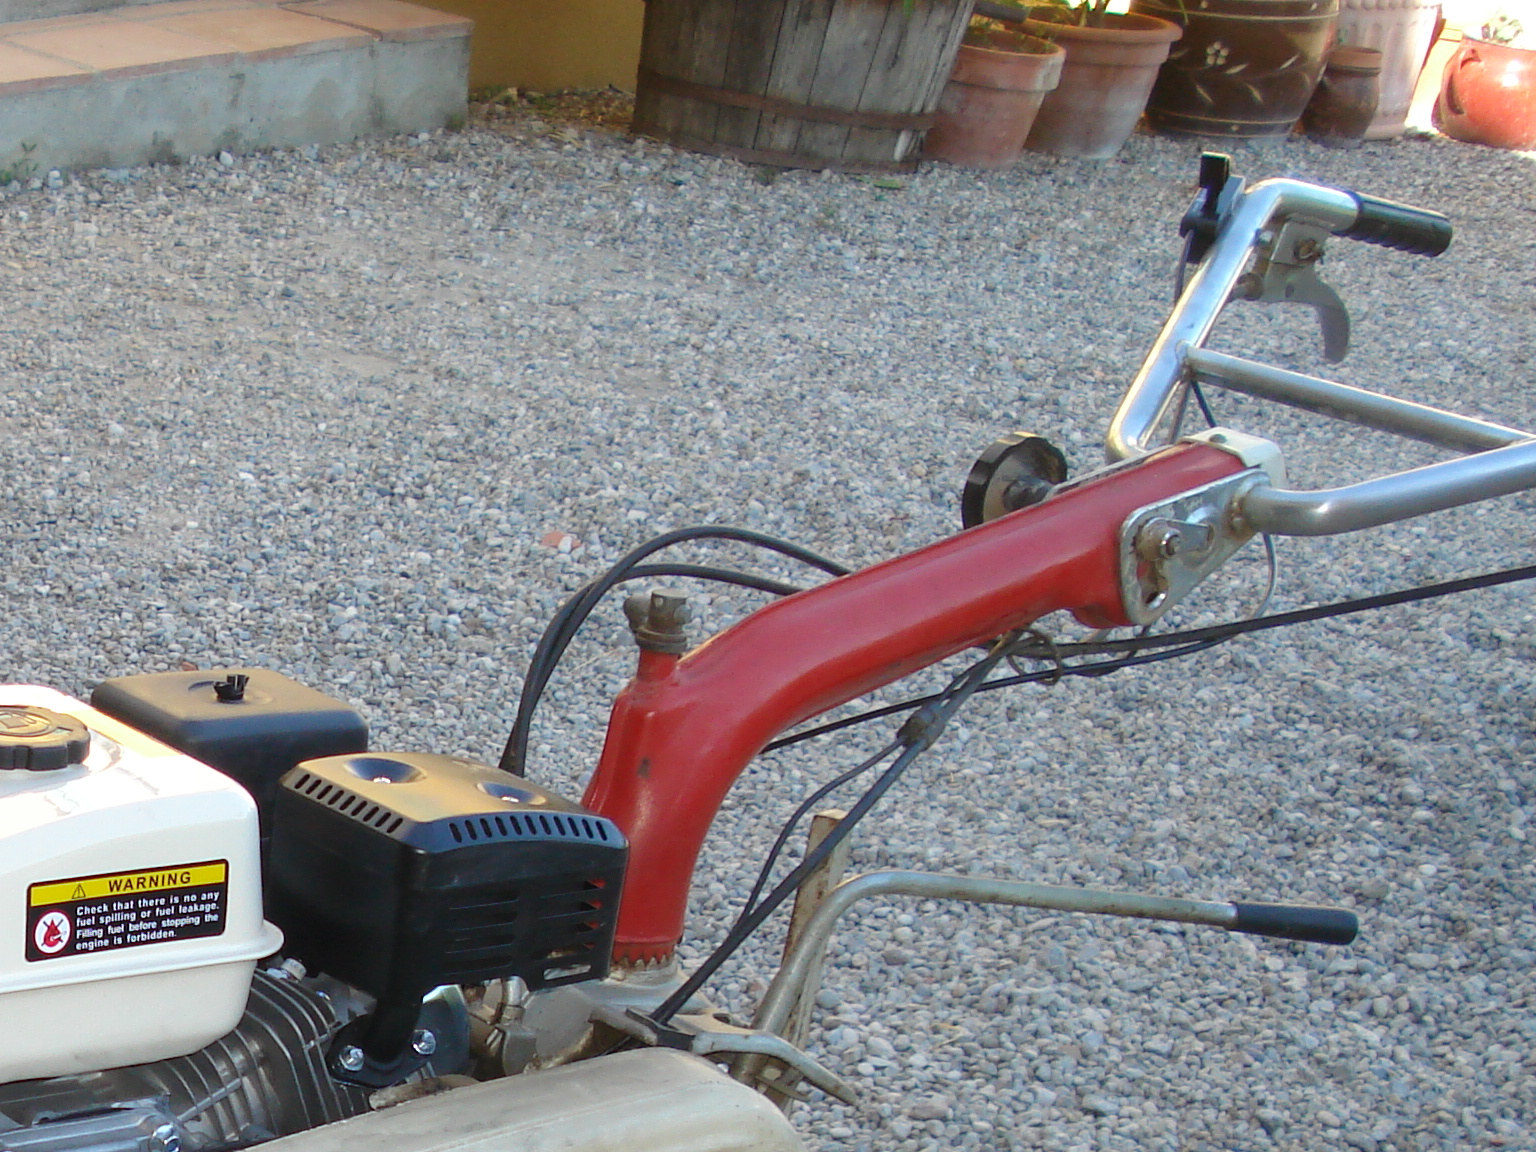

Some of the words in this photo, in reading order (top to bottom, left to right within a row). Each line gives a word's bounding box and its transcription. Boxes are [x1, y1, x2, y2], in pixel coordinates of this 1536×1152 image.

[108, 871, 191, 893] WARNING
[76, 915, 96, 927] fuel
[99, 909, 136, 926] spilling
[140, 909, 152, 919] or
[156, 904, 175, 917] fuel
[179, 901, 219, 916] leakage.
[77, 904, 109, 916] Check
[113, 900, 134, 911] that
[138, 897, 165, 908] there
[170, 894, 179, 904] is
[183, 893, 197, 902] no
[201, 891, 220, 902] any
[76, 926, 103, 939] Filling
[108, 922, 124, 935] fuel
[129, 919, 157, 932] before
[161, 915, 200, 929] stopping
[204, 913, 219, 923] the
[76, 938, 109, 952] engine
[114, 934, 123, 945] is
[127, 929, 177, 944] forbidden.
